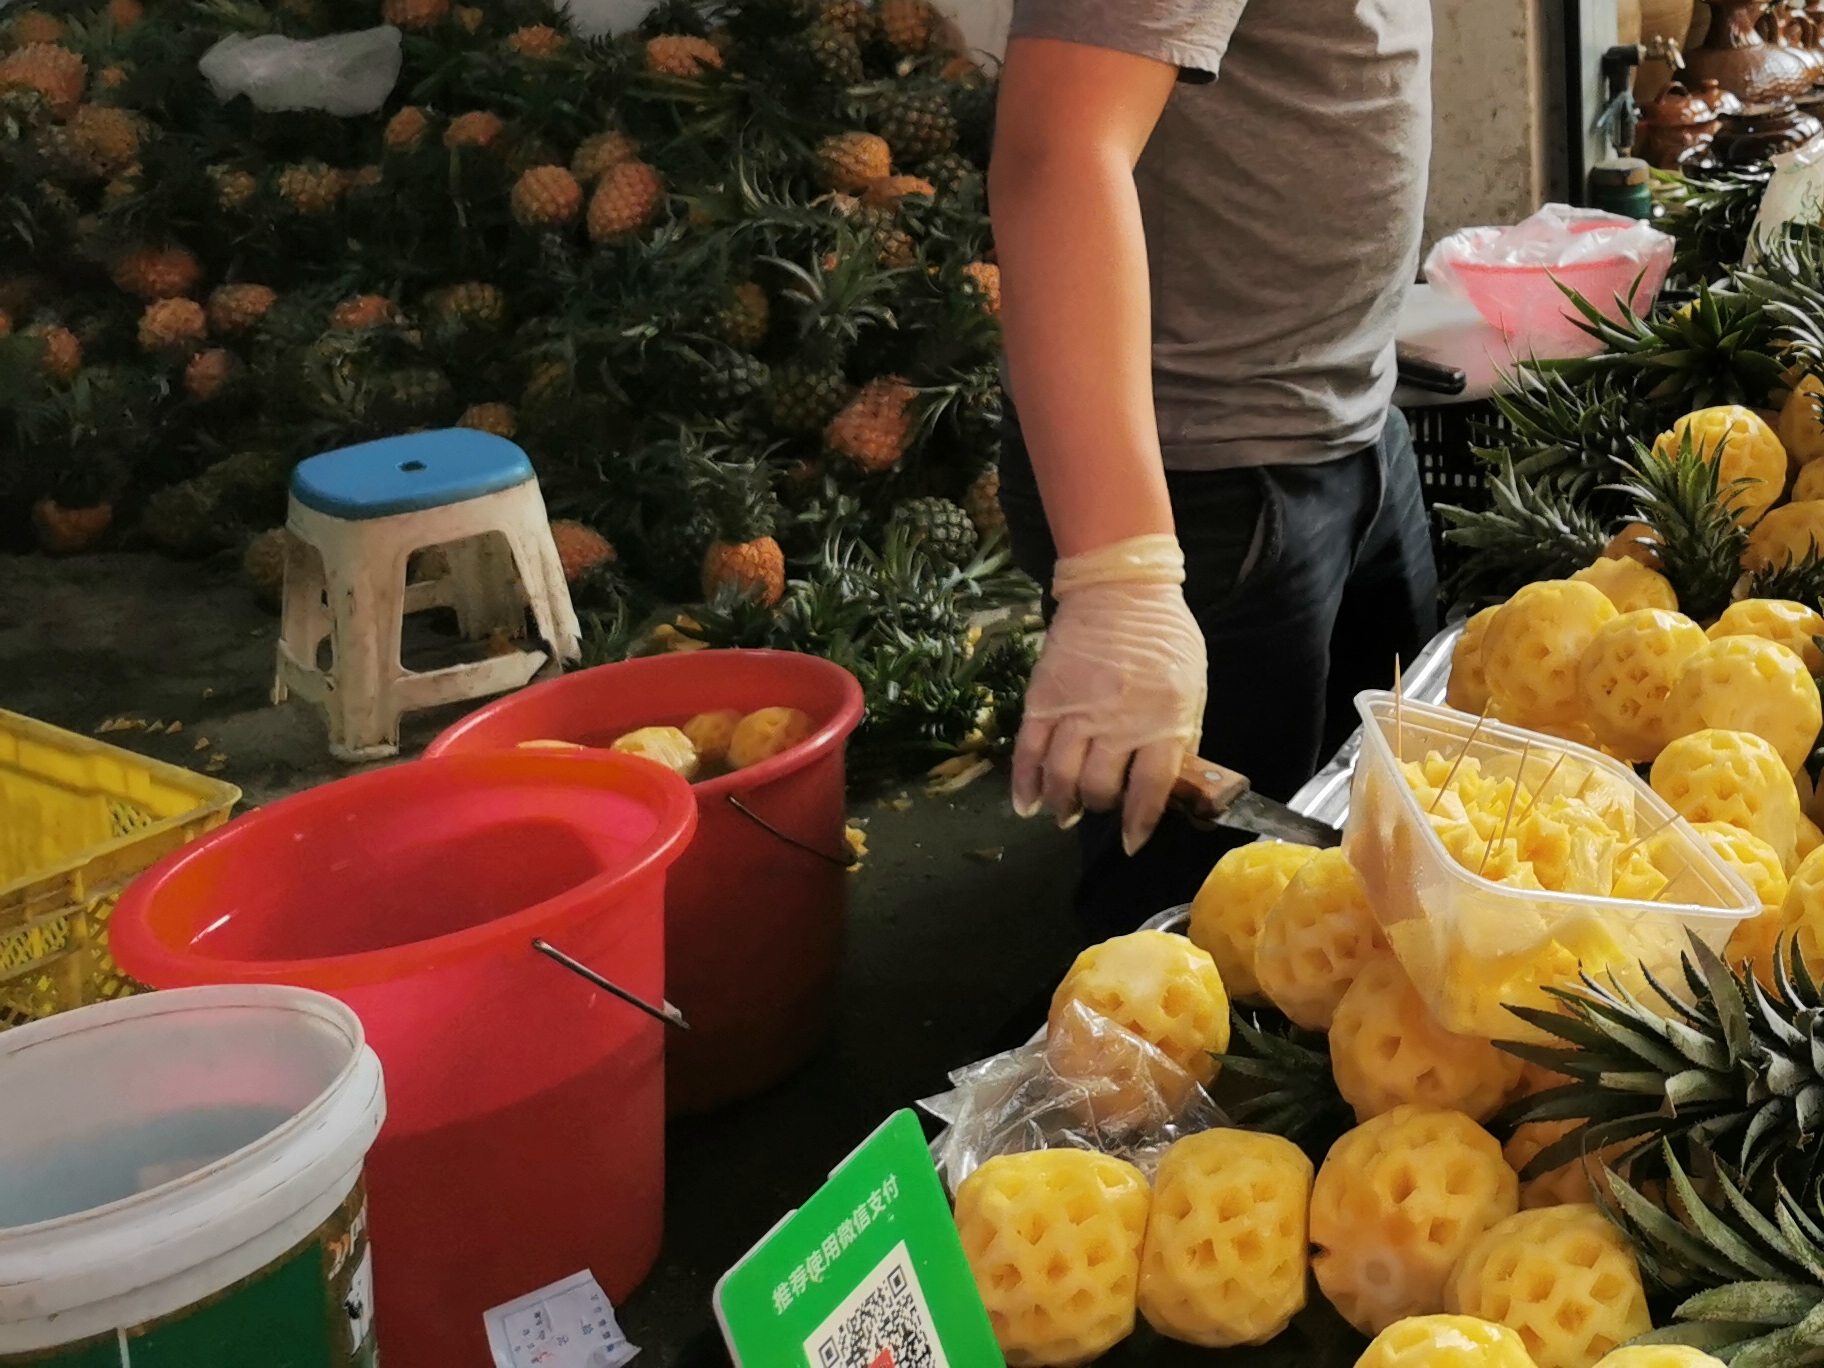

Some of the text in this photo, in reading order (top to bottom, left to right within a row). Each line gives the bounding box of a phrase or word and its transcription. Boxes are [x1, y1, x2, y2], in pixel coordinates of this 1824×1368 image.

[771, 1172, 900, 1316] 推荐使用微信支付
